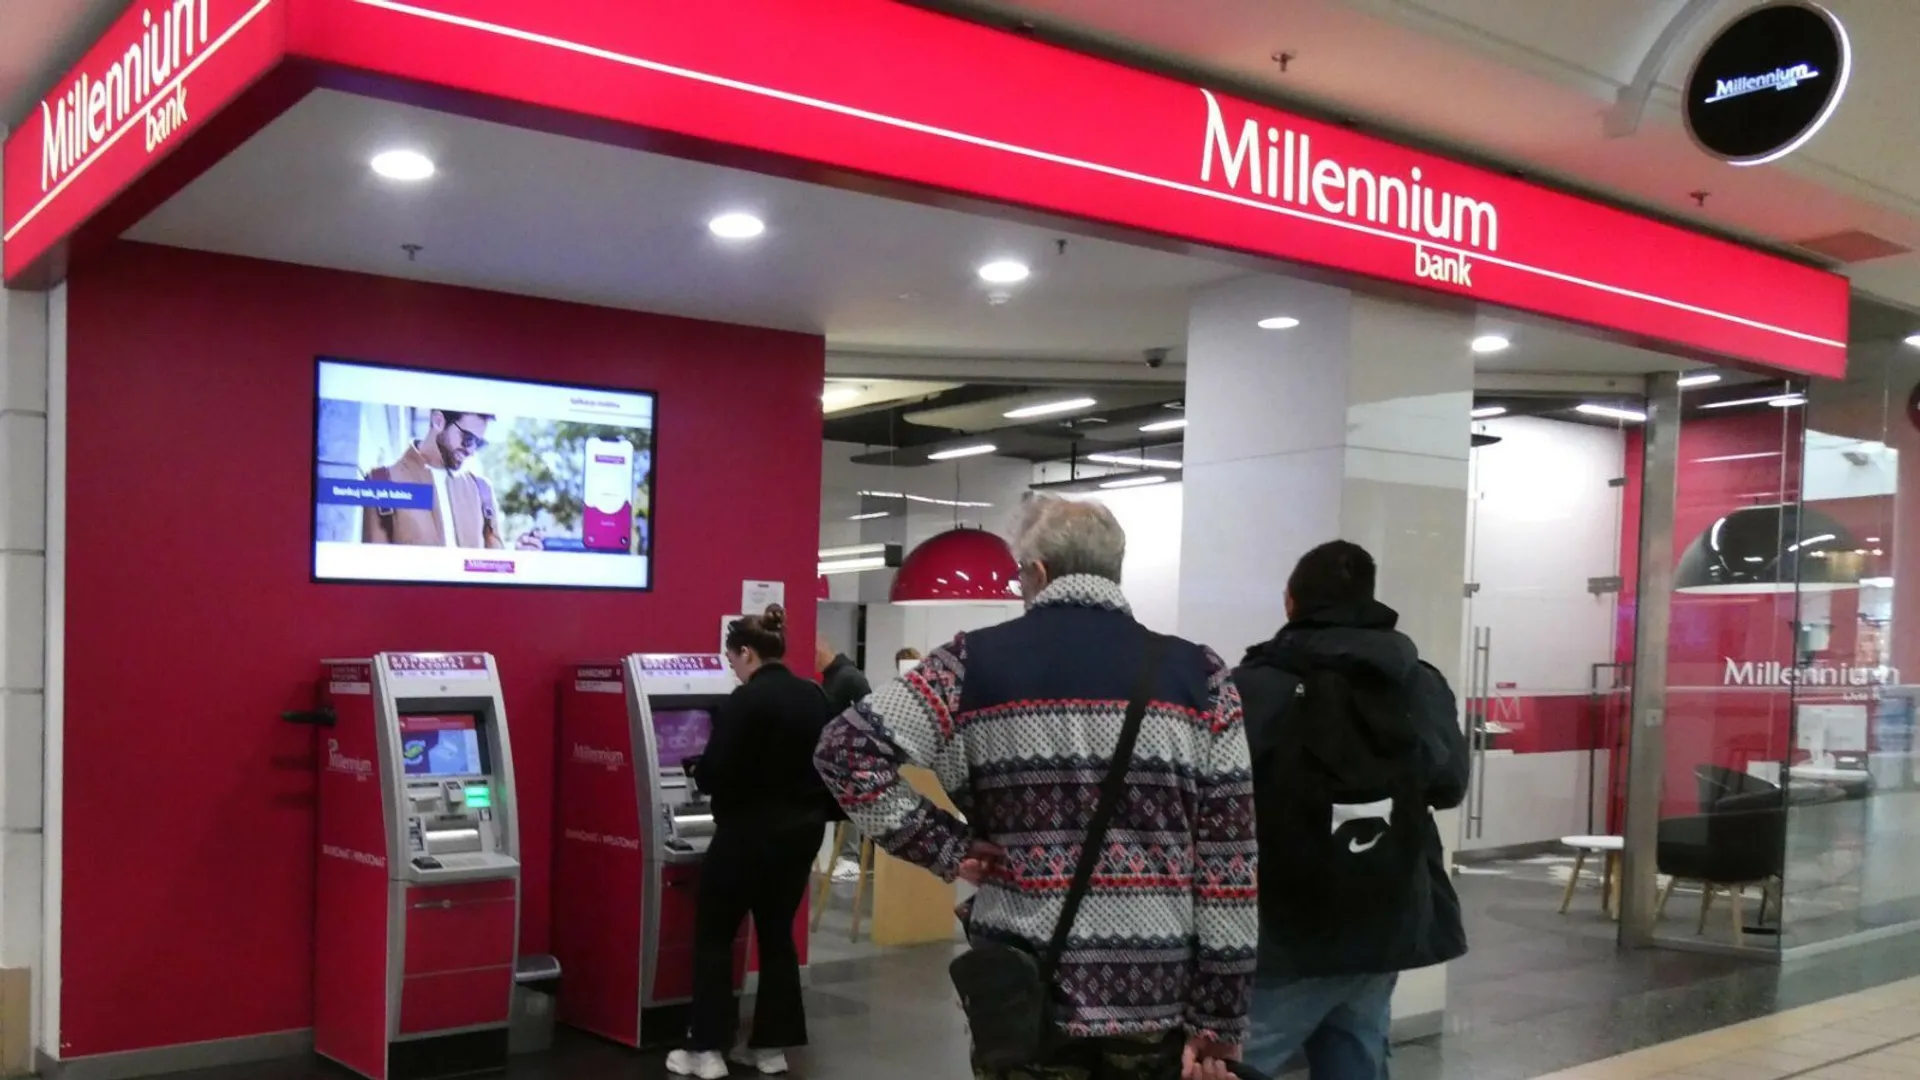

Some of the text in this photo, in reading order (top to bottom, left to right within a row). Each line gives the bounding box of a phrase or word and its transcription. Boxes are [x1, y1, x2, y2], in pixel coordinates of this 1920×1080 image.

[41, 0, 208, 192] Millennium
[1715, 63, 1809, 97] Millennium
[145, 84, 188, 153] bank
[1200, 88, 1498, 251] Millennium
[1415, 241, 1472, 287] bank
[1724, 656, 1901, 685] Millennium
